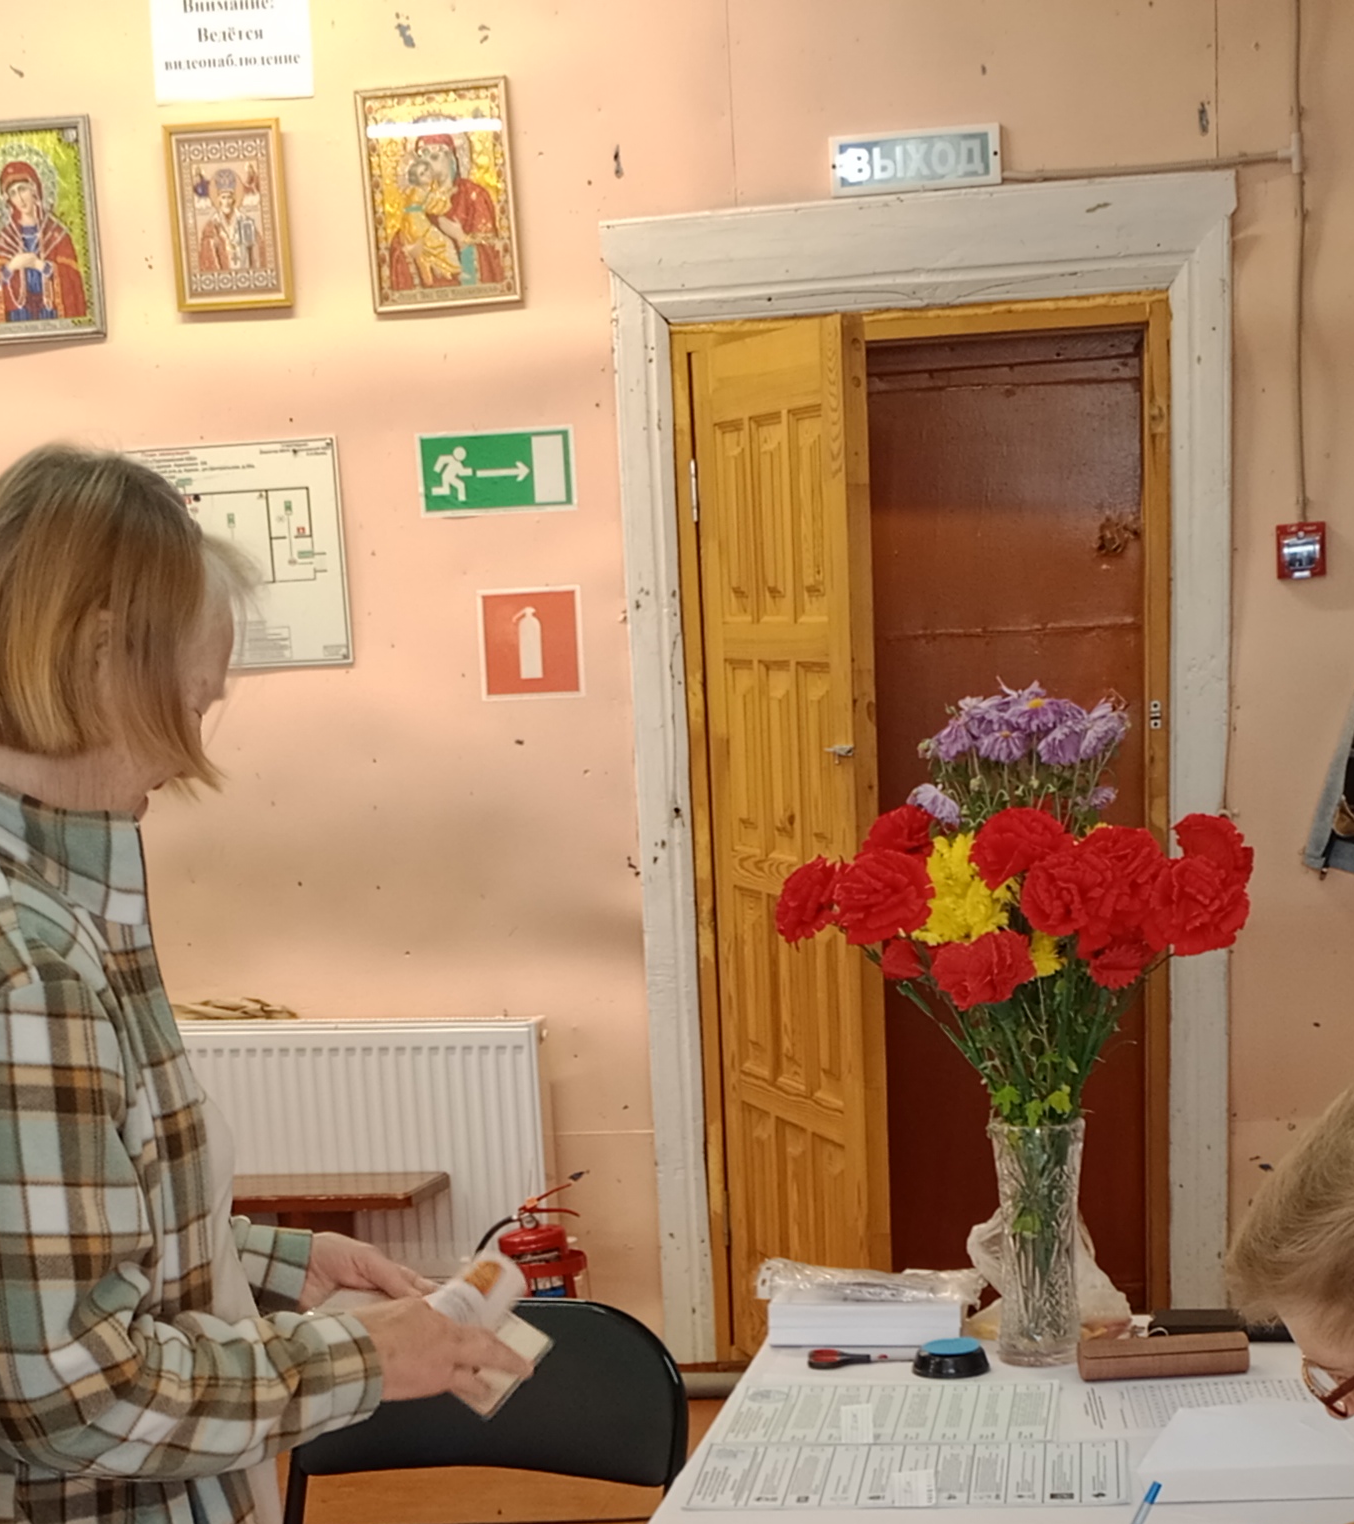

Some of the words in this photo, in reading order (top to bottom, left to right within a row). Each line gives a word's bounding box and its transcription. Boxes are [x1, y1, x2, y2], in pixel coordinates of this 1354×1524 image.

[197, 26, 265, 43] Ведётся
[164, 53, 302, 72] видеонаблюдение
[845, 138, 985, 183] ВЫХОД
